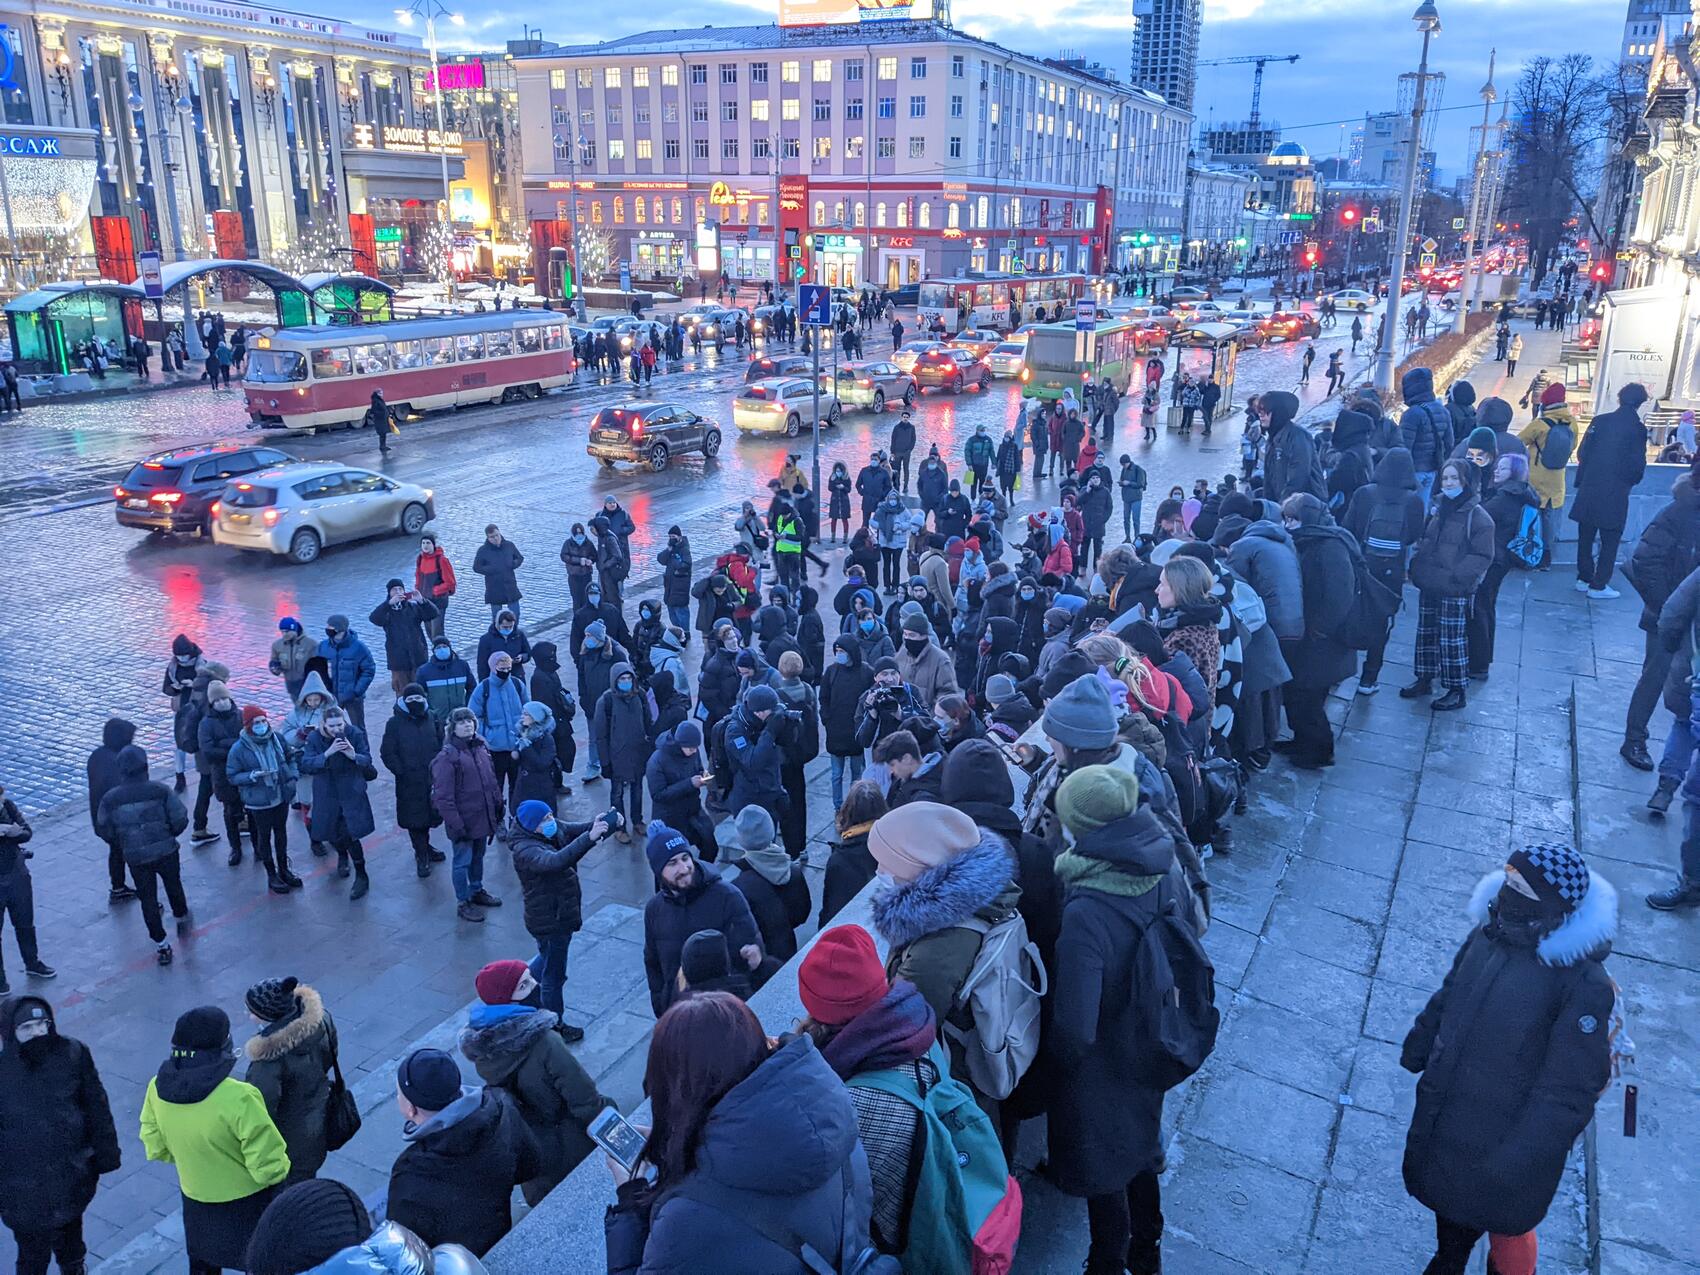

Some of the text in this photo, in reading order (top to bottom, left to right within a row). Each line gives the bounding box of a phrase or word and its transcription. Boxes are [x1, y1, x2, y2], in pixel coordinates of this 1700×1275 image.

[384, 127, 425, 144] ЗОЛОТОЕ
[889, 237, 913, 247] KFC
[991, 312, 1005, 322] KFC
[1630, 353, 1663, 362] ROLEX
